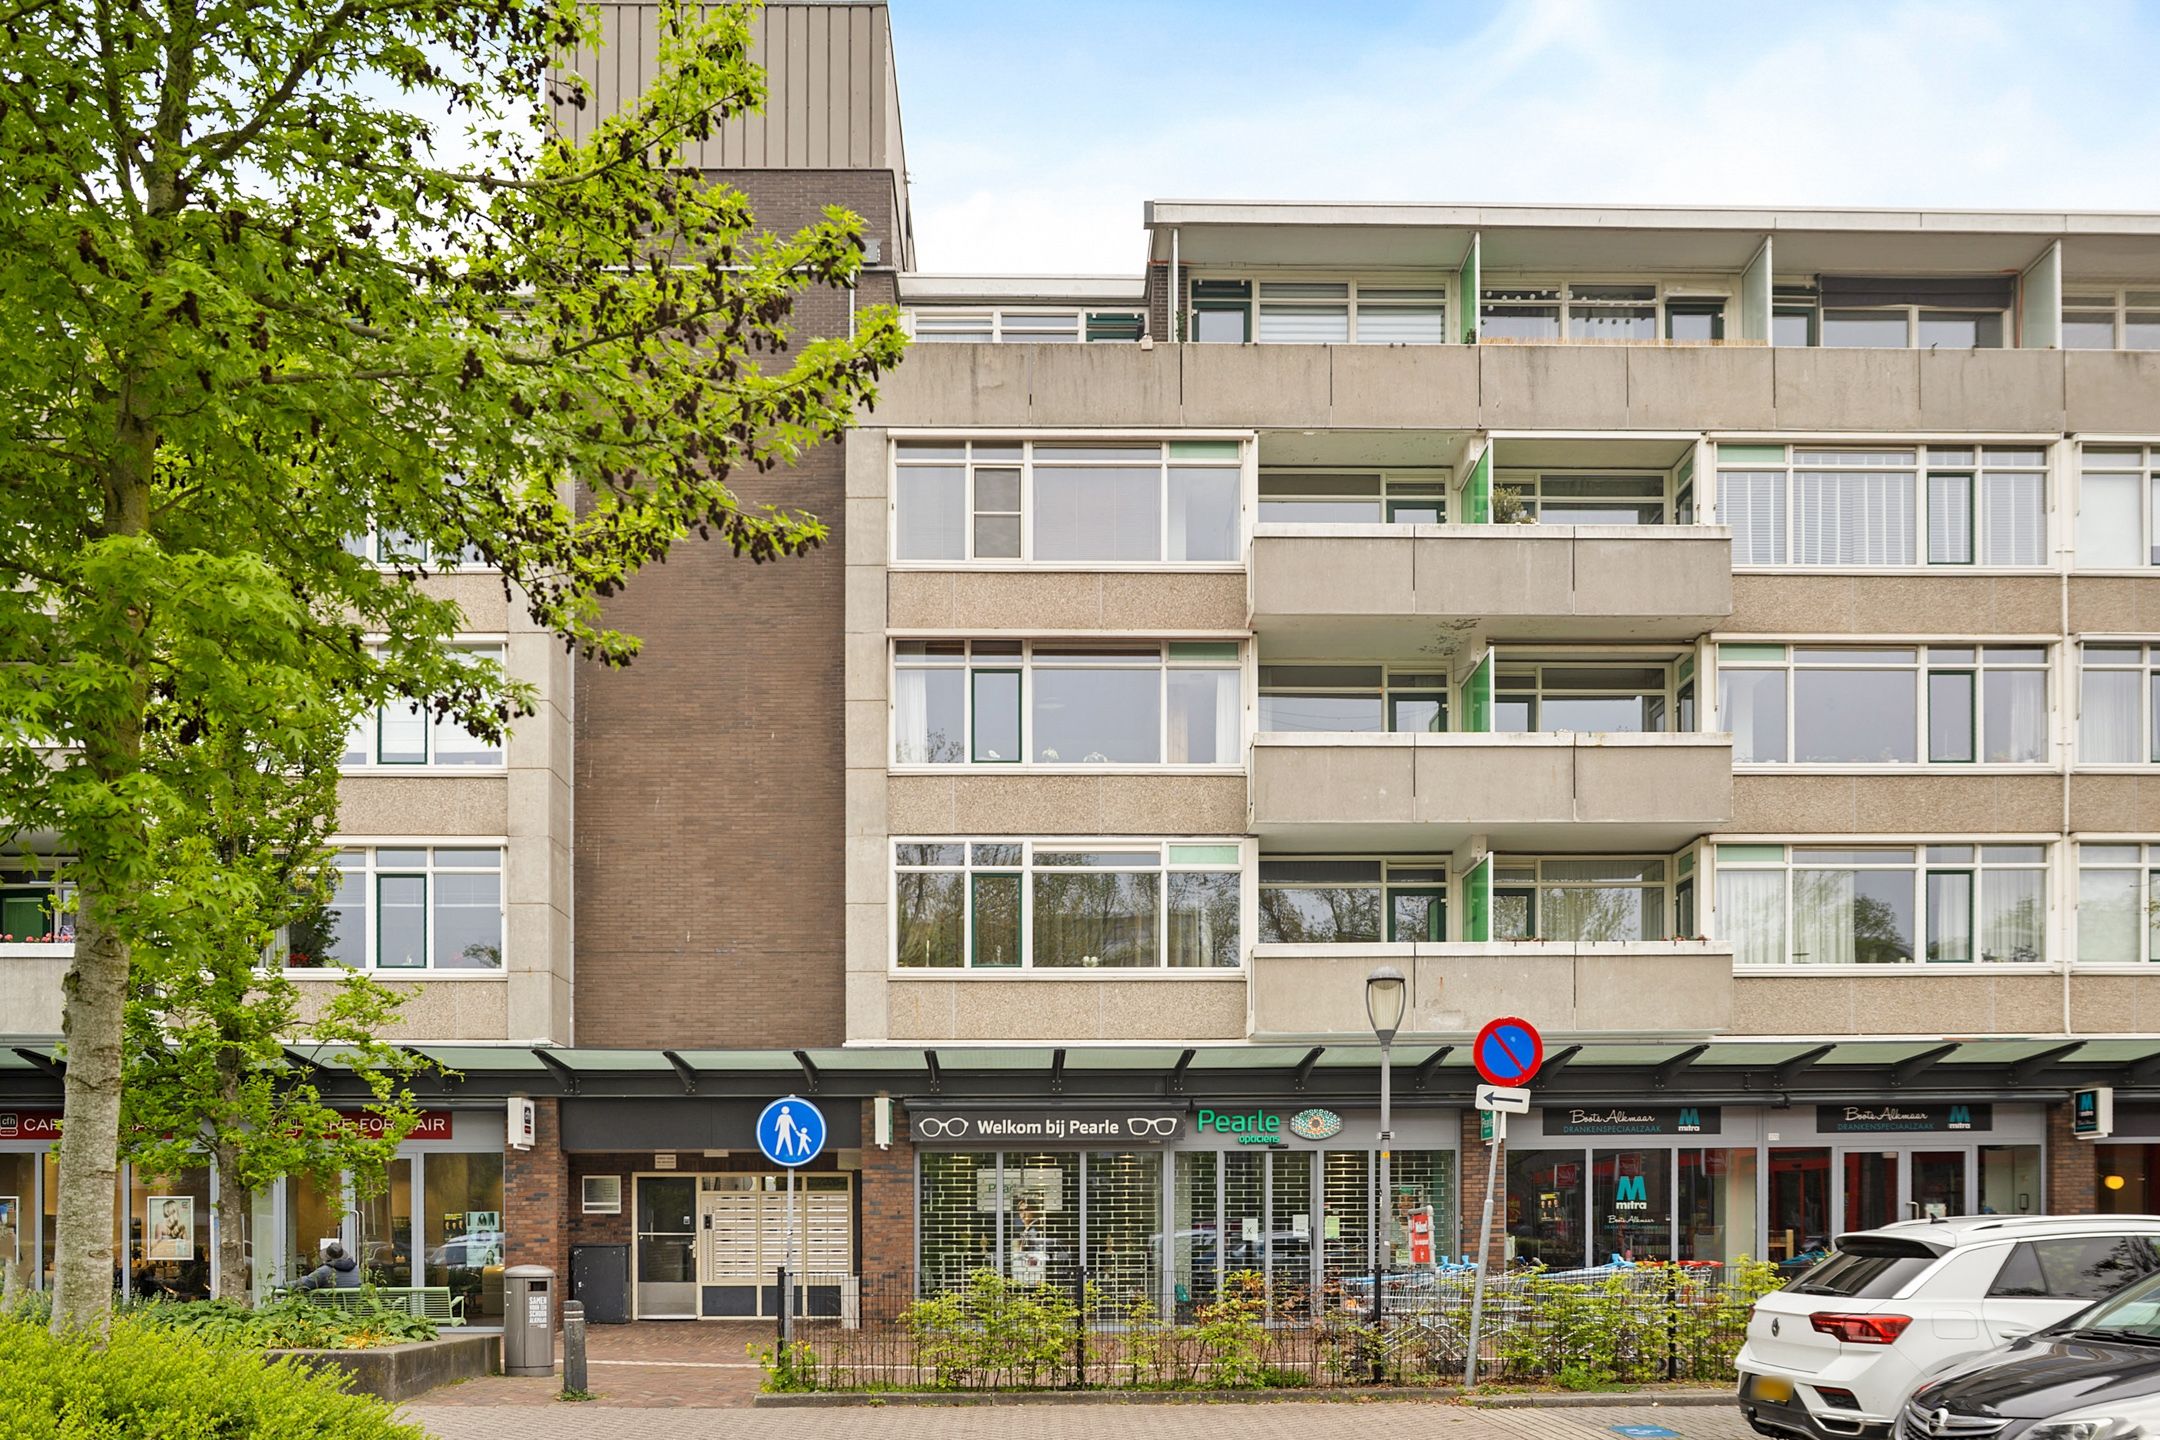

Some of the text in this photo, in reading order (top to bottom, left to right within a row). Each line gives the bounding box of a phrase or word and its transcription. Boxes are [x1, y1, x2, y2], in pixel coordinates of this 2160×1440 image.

[1569, 1109, 1655, 1124] Boots Alkmaar
[1843, 1106, 1928, 1122] Boots Alkmaar
[415, 1118, 446, 1131] AIR
[1198, 1109, 1280, 1133] Pearle
[1948, 1122, 1971, 1130] mitra
[977, 1119, 1119, 1138] Welkom bij Pearle
[1563, 1125, 1662, 1133] DRANKENSPECIAALZAAK
[1678, 1124, 1700, 1132] mitra
[1238, 1135, 1281, 1145] opticiens
[1616, 1200, 1647, 1210] mitra
